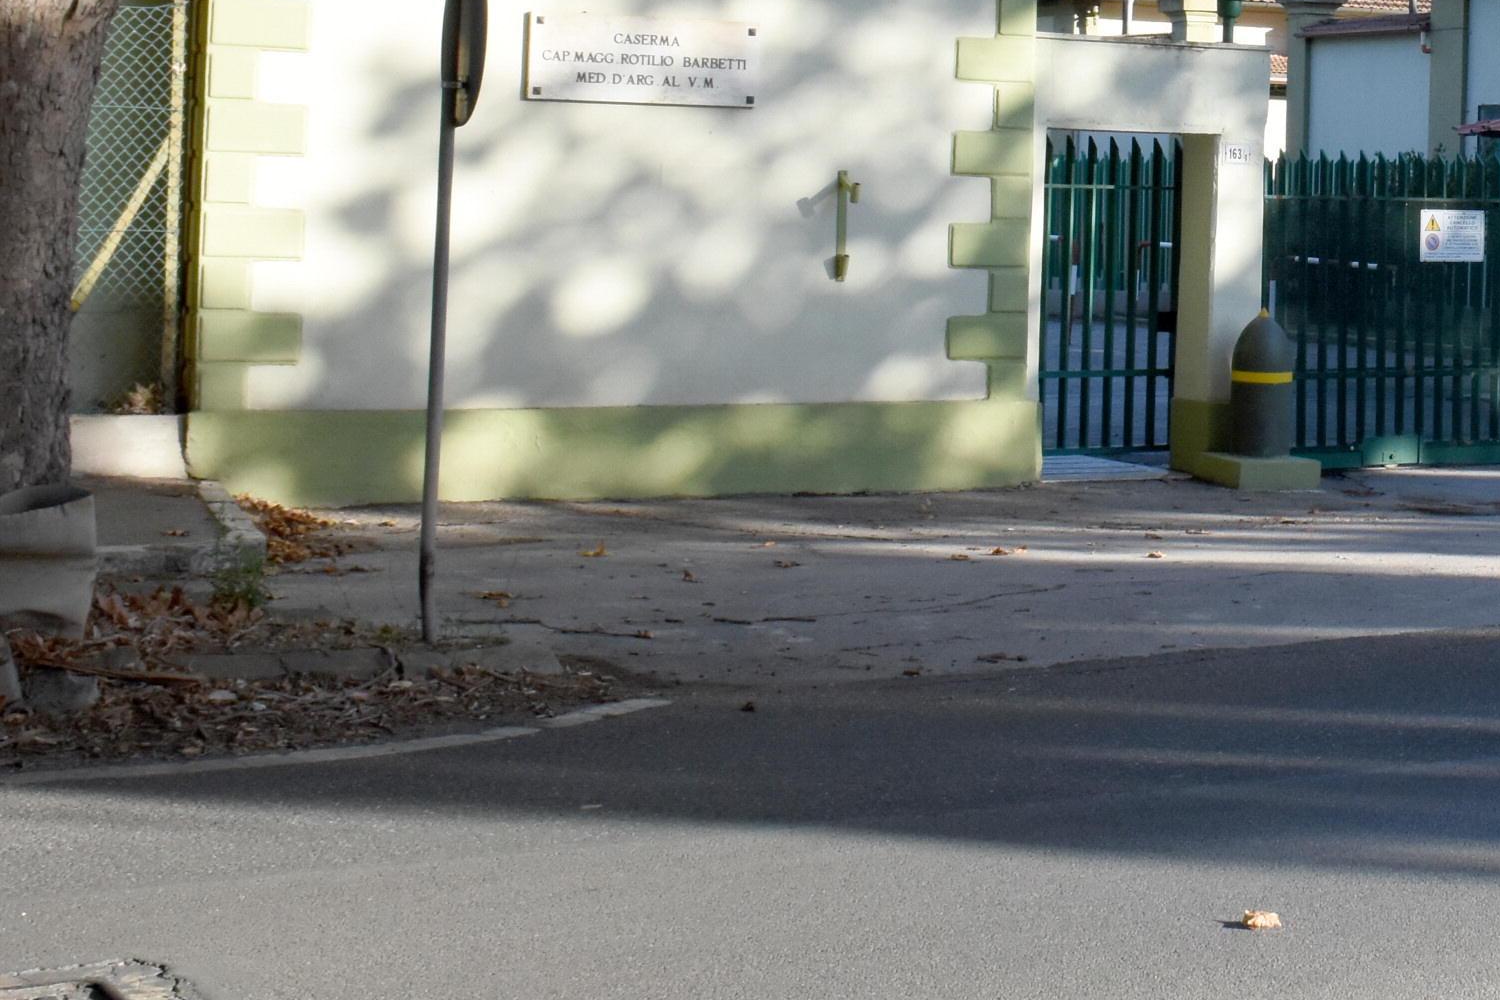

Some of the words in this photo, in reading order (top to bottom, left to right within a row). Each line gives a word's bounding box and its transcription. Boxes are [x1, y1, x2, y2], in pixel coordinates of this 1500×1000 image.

[614, 33, 680, 47] CASERMA
[620, 53, 674, 67] ROTILIO
[683, 56, 747, 70] BARBETTI
[662, 75, 681, 88] AL
